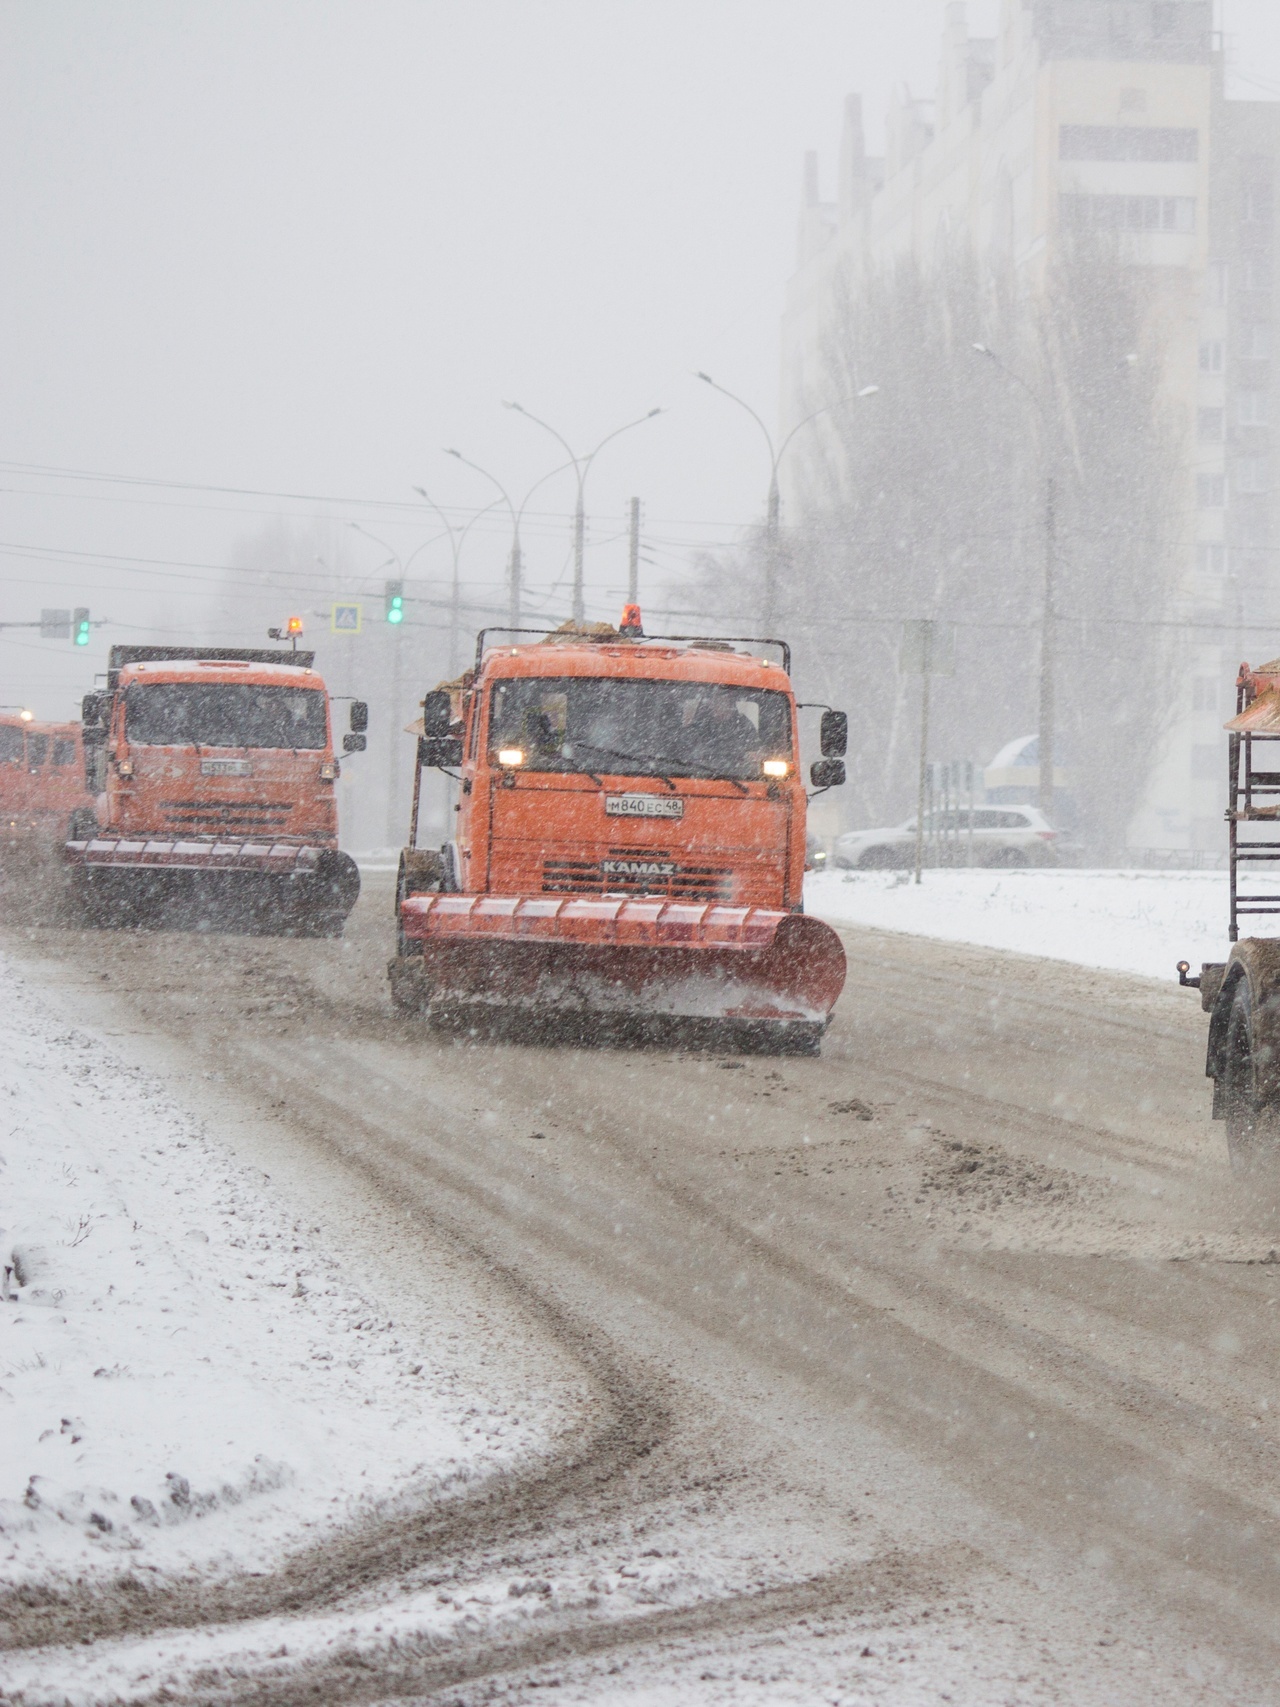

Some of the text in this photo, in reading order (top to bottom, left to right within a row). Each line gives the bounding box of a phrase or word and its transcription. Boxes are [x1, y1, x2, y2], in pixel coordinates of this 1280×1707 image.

[611, 800, 662, 813] M840EC
[665, 800, 678, 811] 48
[603, 861, 675, 875] KAMAZ
